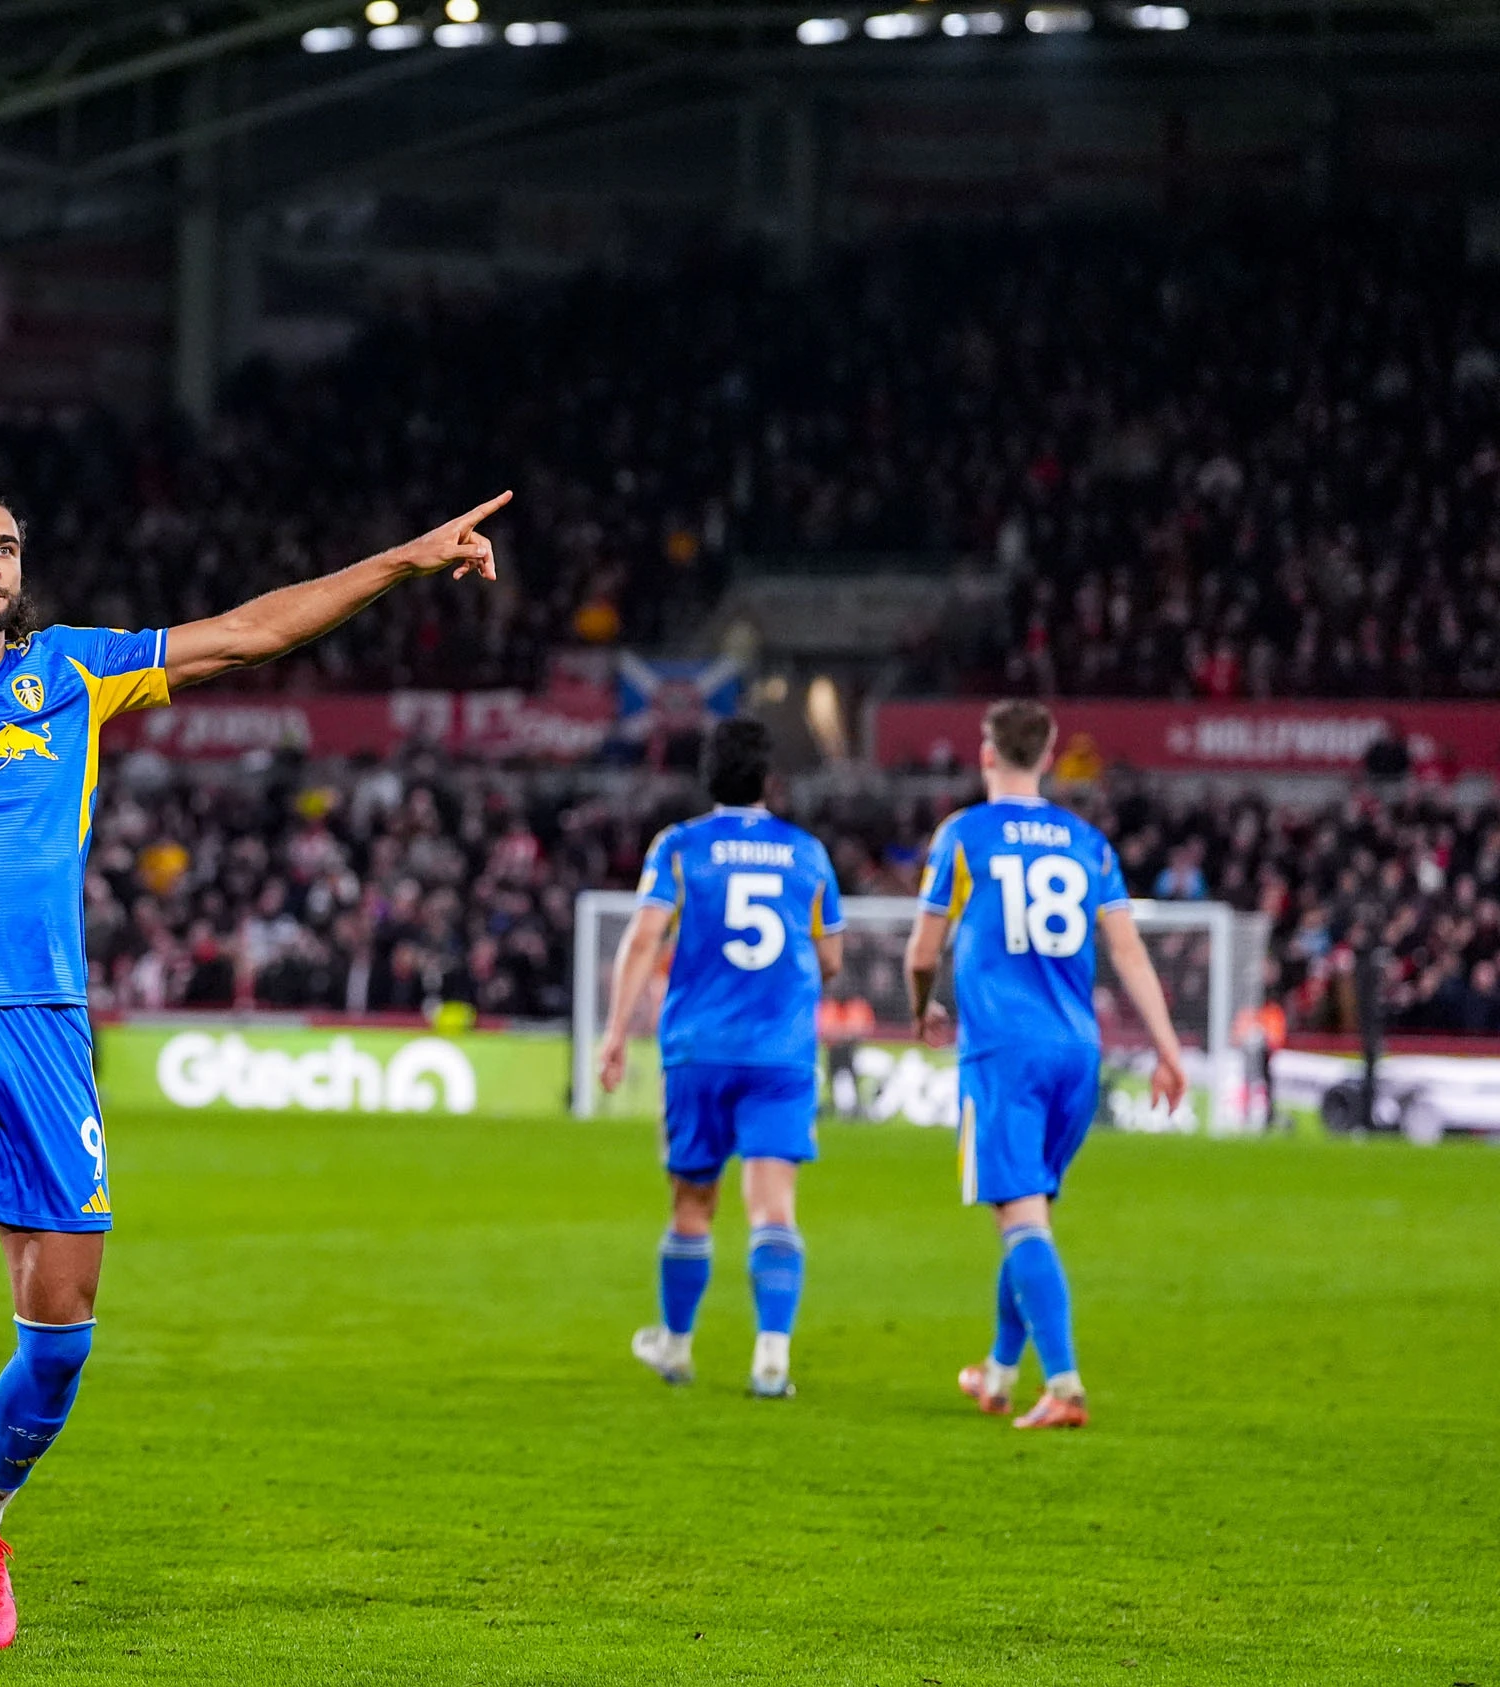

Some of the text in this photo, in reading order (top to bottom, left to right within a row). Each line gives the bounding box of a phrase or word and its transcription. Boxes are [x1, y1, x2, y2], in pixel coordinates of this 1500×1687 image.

[1002, 820, 1071, 848] STACH
[722, 872, 786, 971] 5
[989, 854, 1089, 958] 18
[80, 1115, 103, 1181] 9
